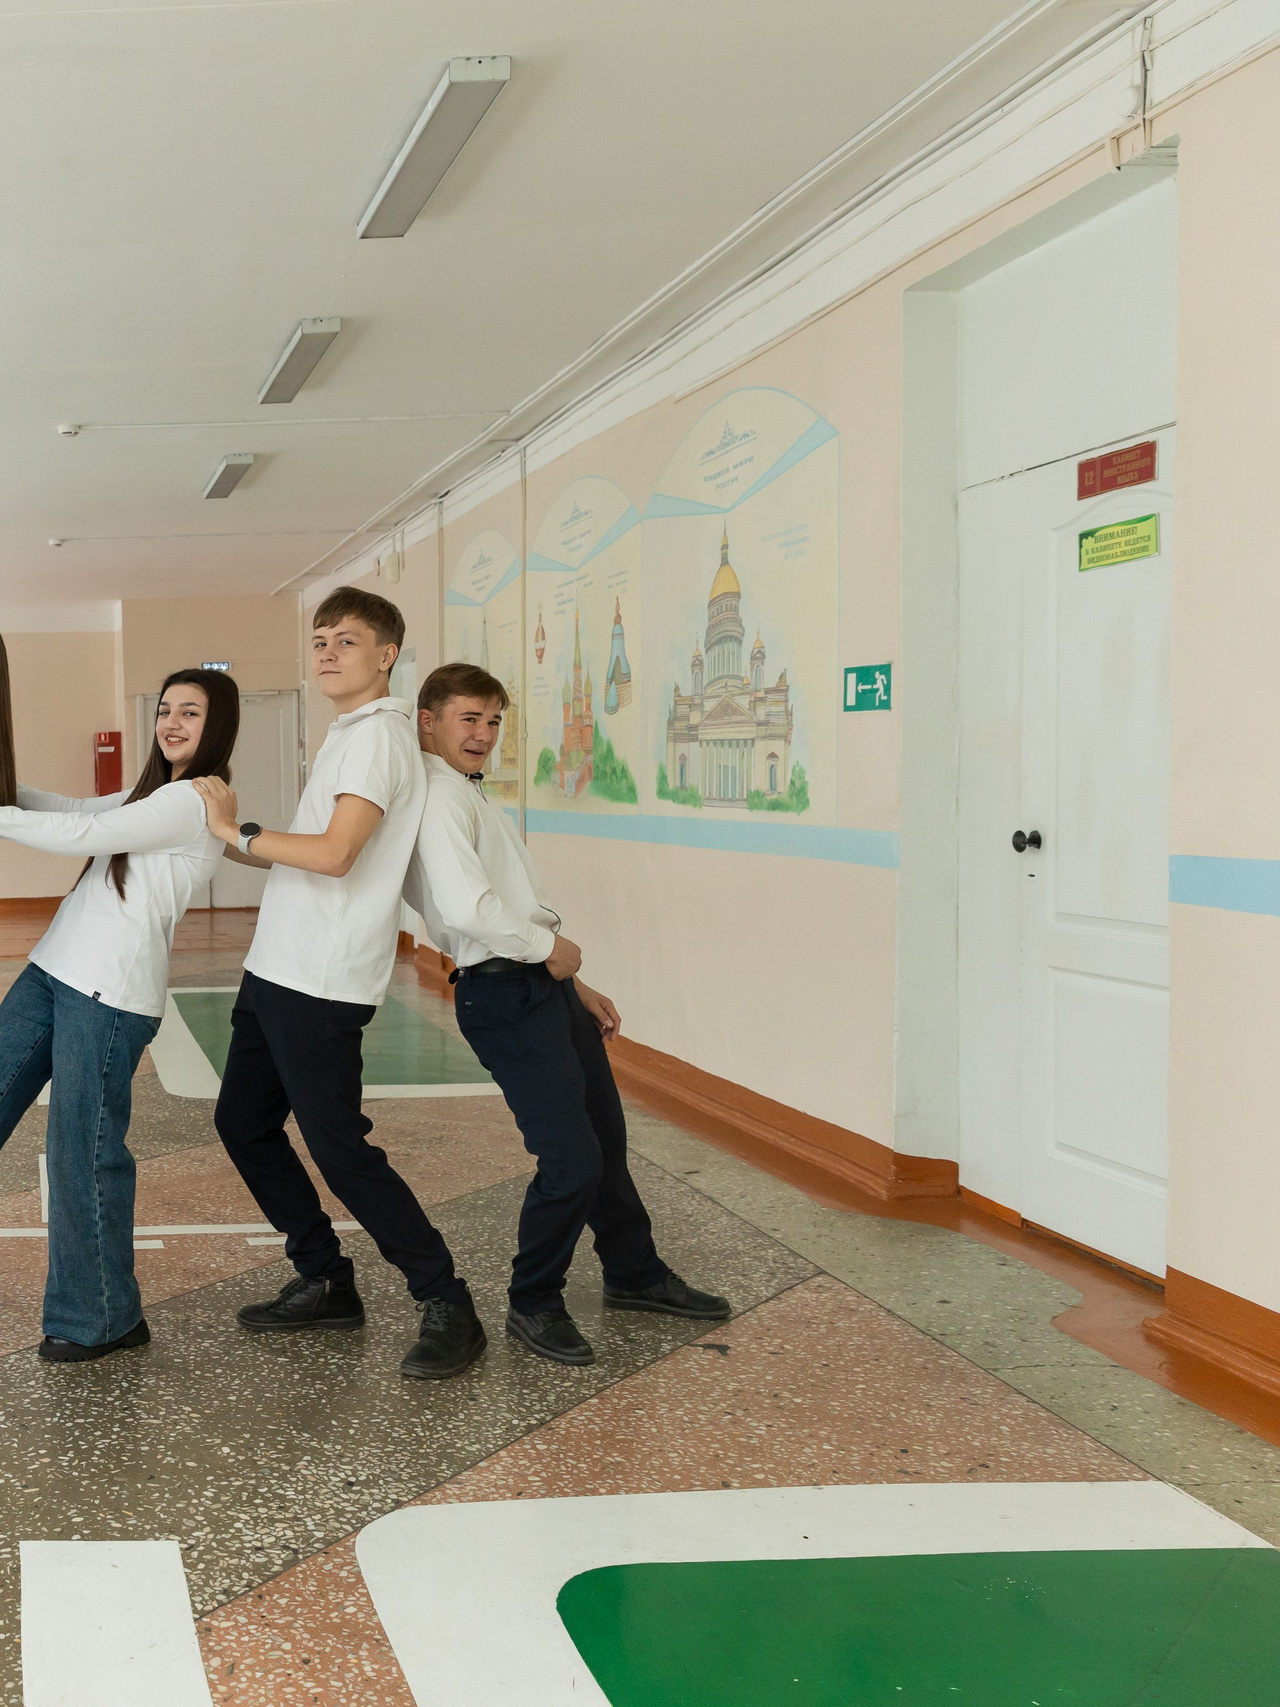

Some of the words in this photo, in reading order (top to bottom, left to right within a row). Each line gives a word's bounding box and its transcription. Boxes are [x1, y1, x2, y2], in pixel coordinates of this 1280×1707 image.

[1113, 450, 1141, 465] КАБИНЕТ
[1103, 457, 1152, 478] ИНОСТРАННОГО
[1084, 471, 1094, 486] 12
[1117, 471, 1139, 485] ЯЗЫКА
[1094, 526, 1138, 544] ВНИМАНИЕ!
[1085, 548, 1090, 556] В
[1091, 540, 1122, 554] КАБИНЕТЕ
[1124, 534, 1151, 548] ВЕДЕТСЯ
[1087, 544, 1150, 565] ВИДЕОНАБЛЮДЕНИЕ
